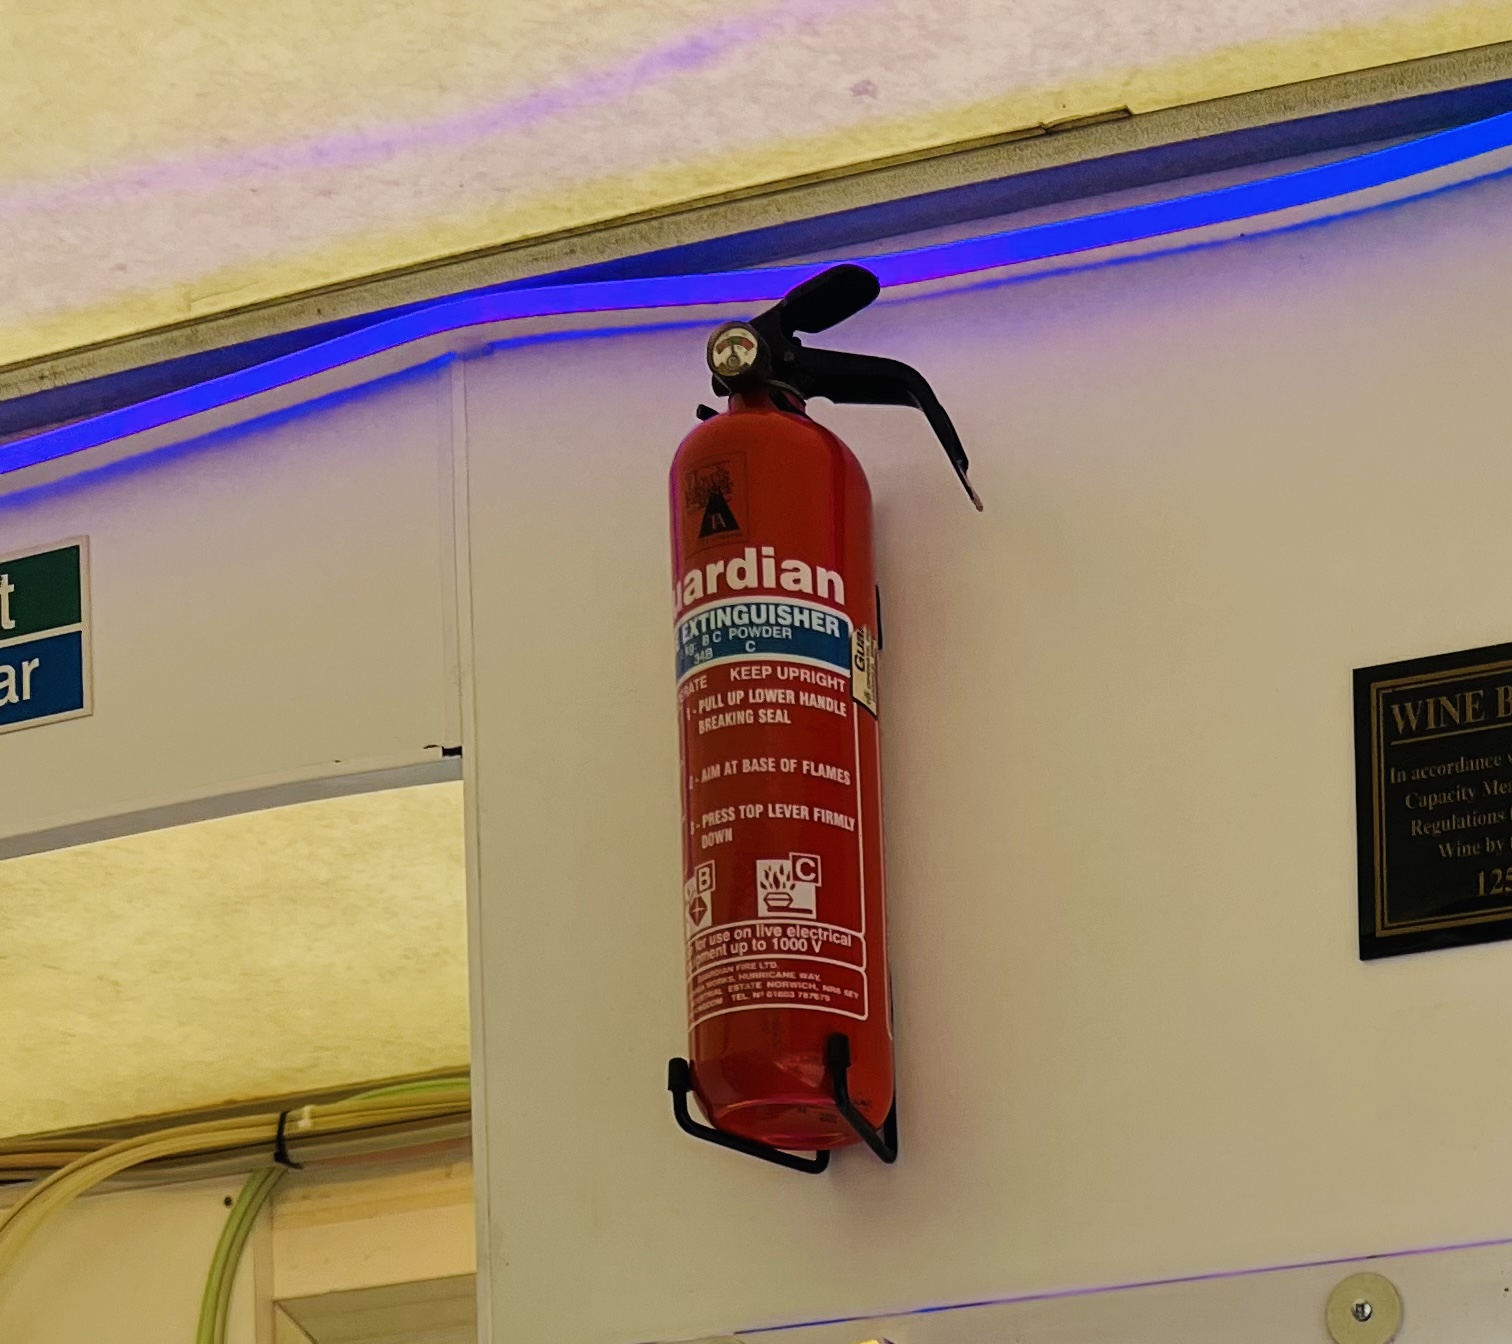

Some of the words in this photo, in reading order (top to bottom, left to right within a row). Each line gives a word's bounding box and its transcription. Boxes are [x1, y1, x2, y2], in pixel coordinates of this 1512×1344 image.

[682, 604, 841, 645] EXTINGUISHER
[729, 626, 793, 640] POWDER
[730, 666, 772, 682] KEEP
[777, 667, 846, 692] UPRIGHT
[699, 692, 726, 714] PULL
[727, 690, 744, 706] UP
[748, 688, 795, 705] LOWER
[799, 691, 847, 717] HANDLE
[1391, 689, 1486, 734] WINE
[698, 709, 754, 735] BREAKING
[758, 709, 792, 724] SEAL
[701, 763, 722, 784] AIM
[724, 760, 739, 777] AT
[742, 757, 776, 774] BASE
[780, 758, 798, 773] OF
[802, 760, 852, 786] FLAMES
[1390, 767, 1407, 784] In
[1405, 784, 1476, 812] Capacity
[702, 805, 736, 830] PRESS
[739, 803, 764, 819] TOP
[768, 803, 810, 820] LEVER
[813, 807, 856, 831] FIRMLY
[1411, 810, 1505, 837] Regulations
[701, 827, 733, 850] DOWN
[1439, 841, 1480, 859] Wine
[1486, 836, 1504, 856] by
[795, 857, 817, 882] C
[708, 931, 731, 946] use
[734, 928, 753, 941] on
[756, 923, 782, 938] live
[786, 924, 852, 948] electrical
[730, 941, 748, 956] up
[752, 939, 767, 952] to
[772, 937, 808, 952] 1000
[811, 940, 823, 954] V
